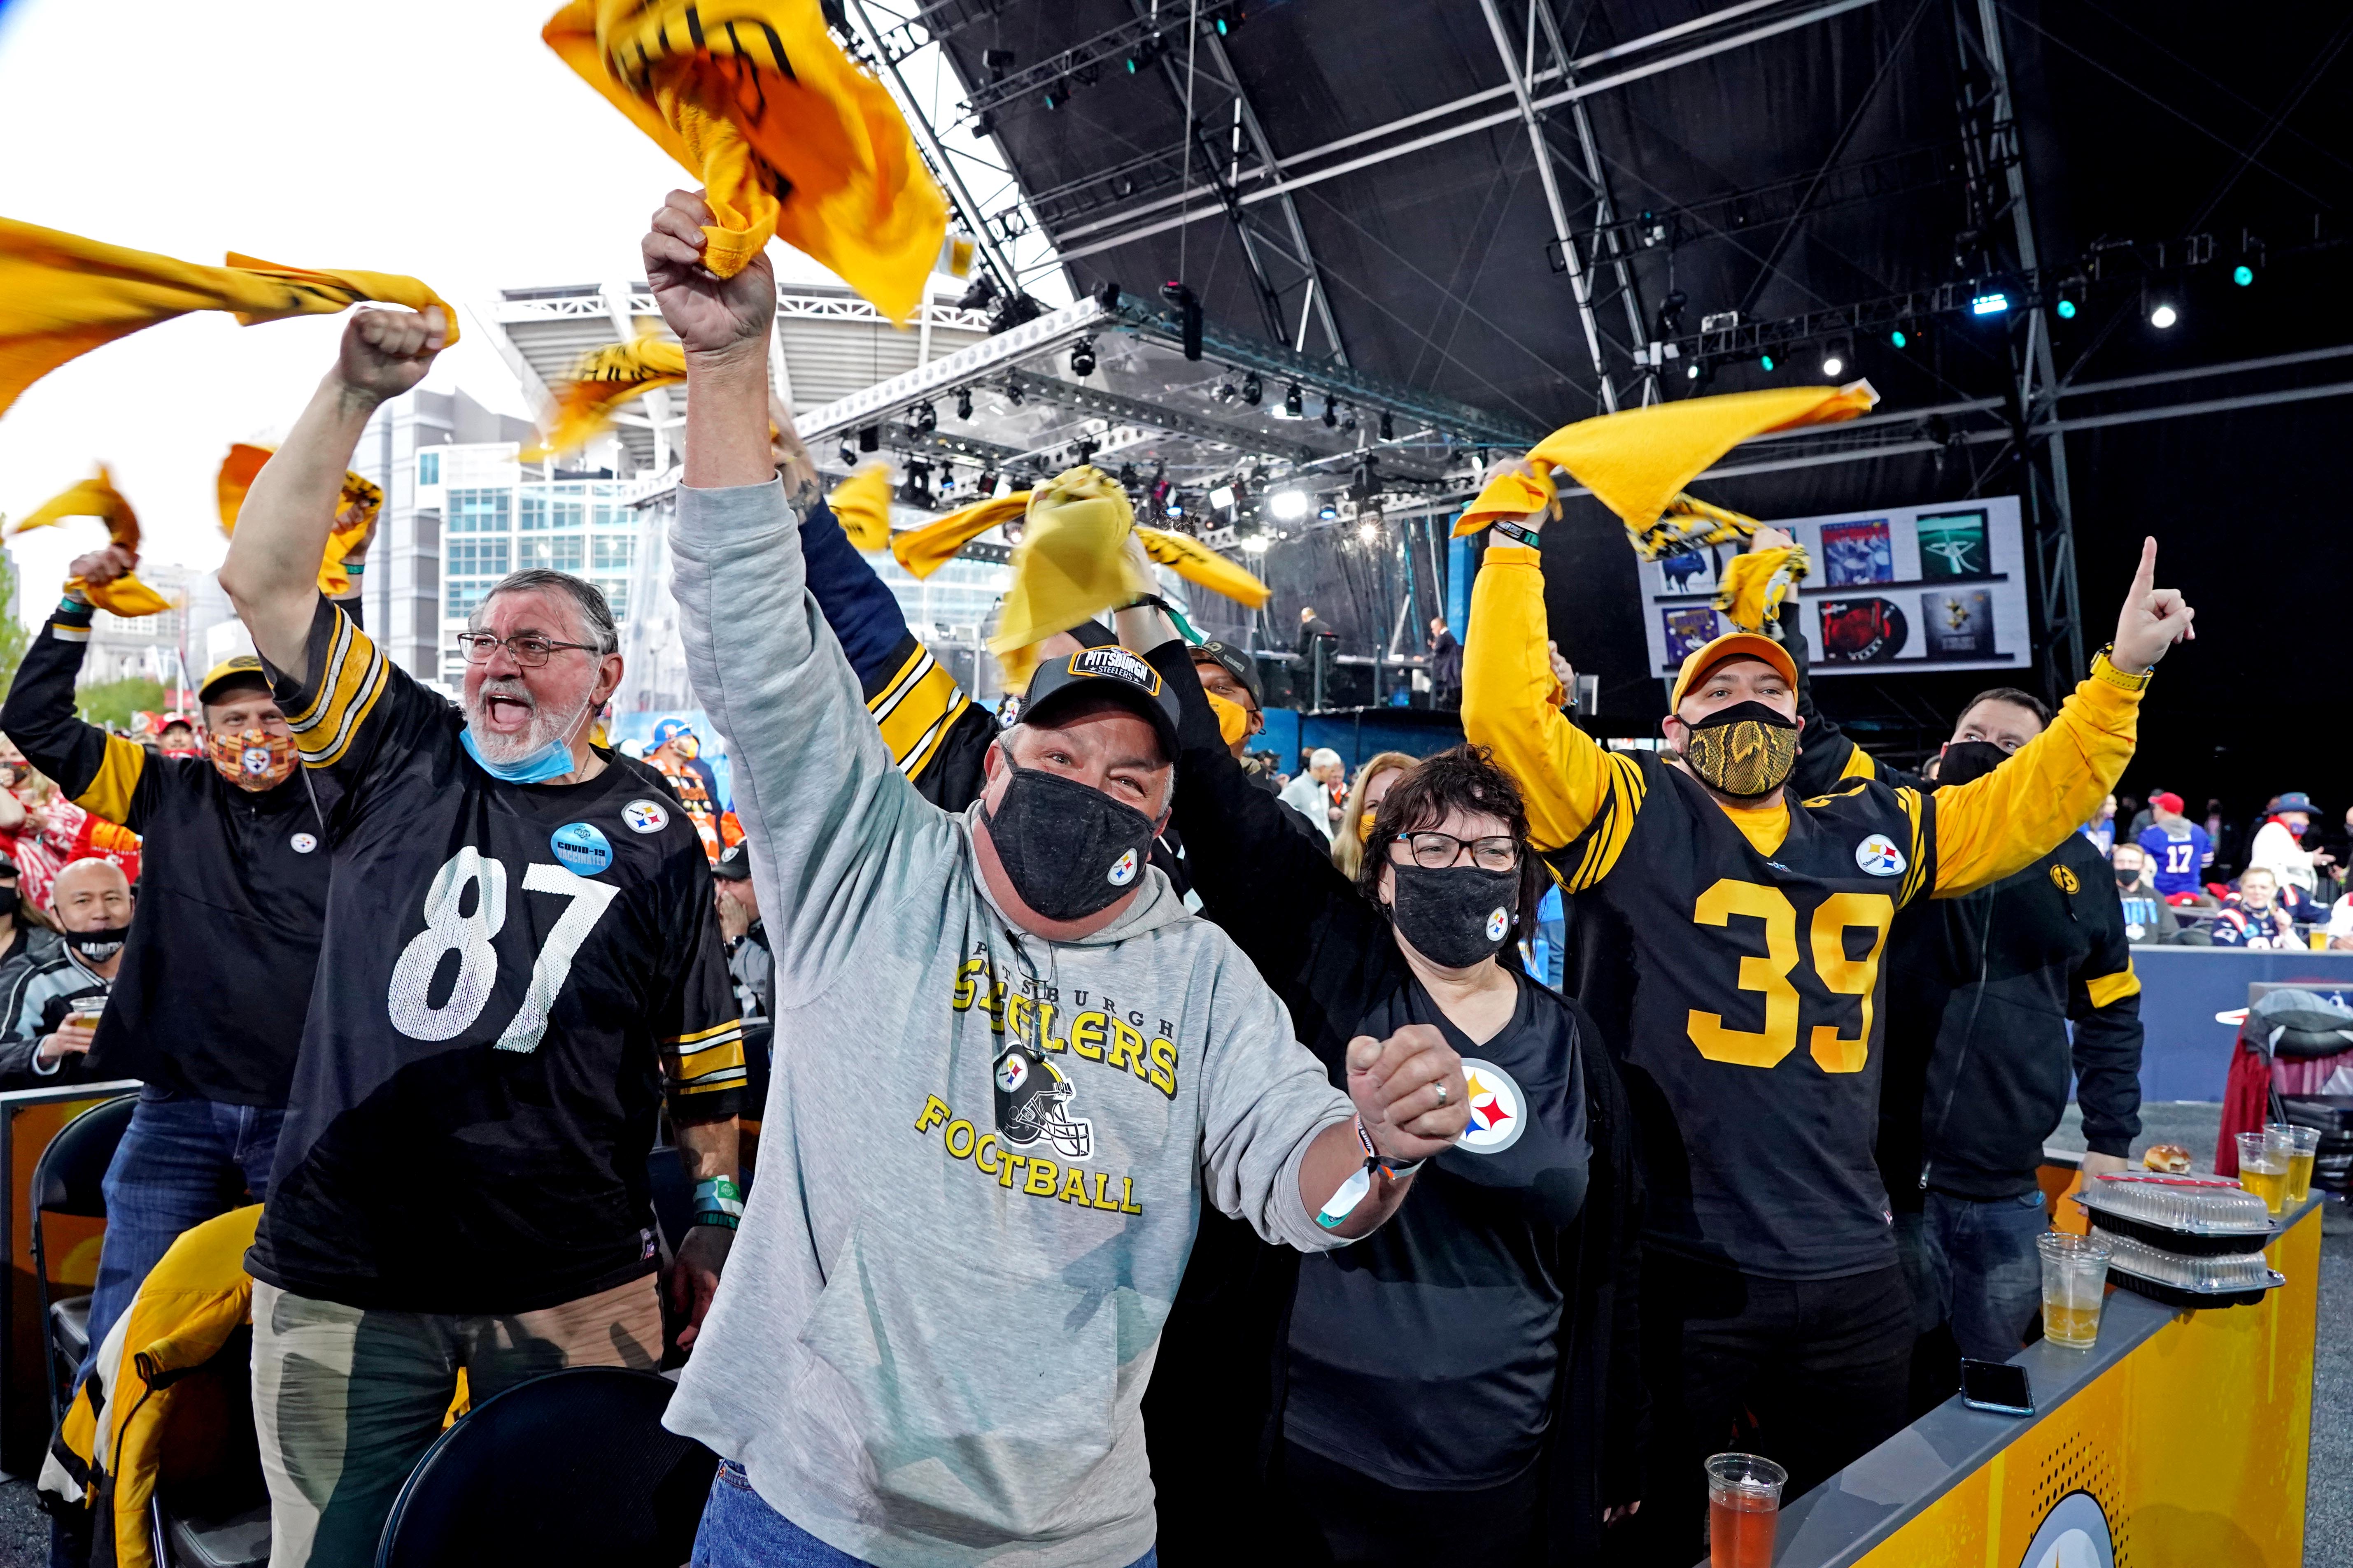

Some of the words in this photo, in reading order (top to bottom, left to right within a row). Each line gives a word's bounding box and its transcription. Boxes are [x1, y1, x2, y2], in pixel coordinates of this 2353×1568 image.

[1084, 651, 1148, 682] PITTSBURGH
[1098, 665, 1134, 681] STEELERS
[557, 841, 605, 856] COVID-19
[557, 847, 606, 866] VACCINATED
[1862, 855, 1882, 867] Steelers
[2166, 845, 2194, 873] 17
[388, 846, 620, 1053] 87
[973, 941, 1174, 1039] PTSBURGH
[1687, 878, 1894, 1073] 39
[914, 1093, 1142, 1216] FOOTBALL
